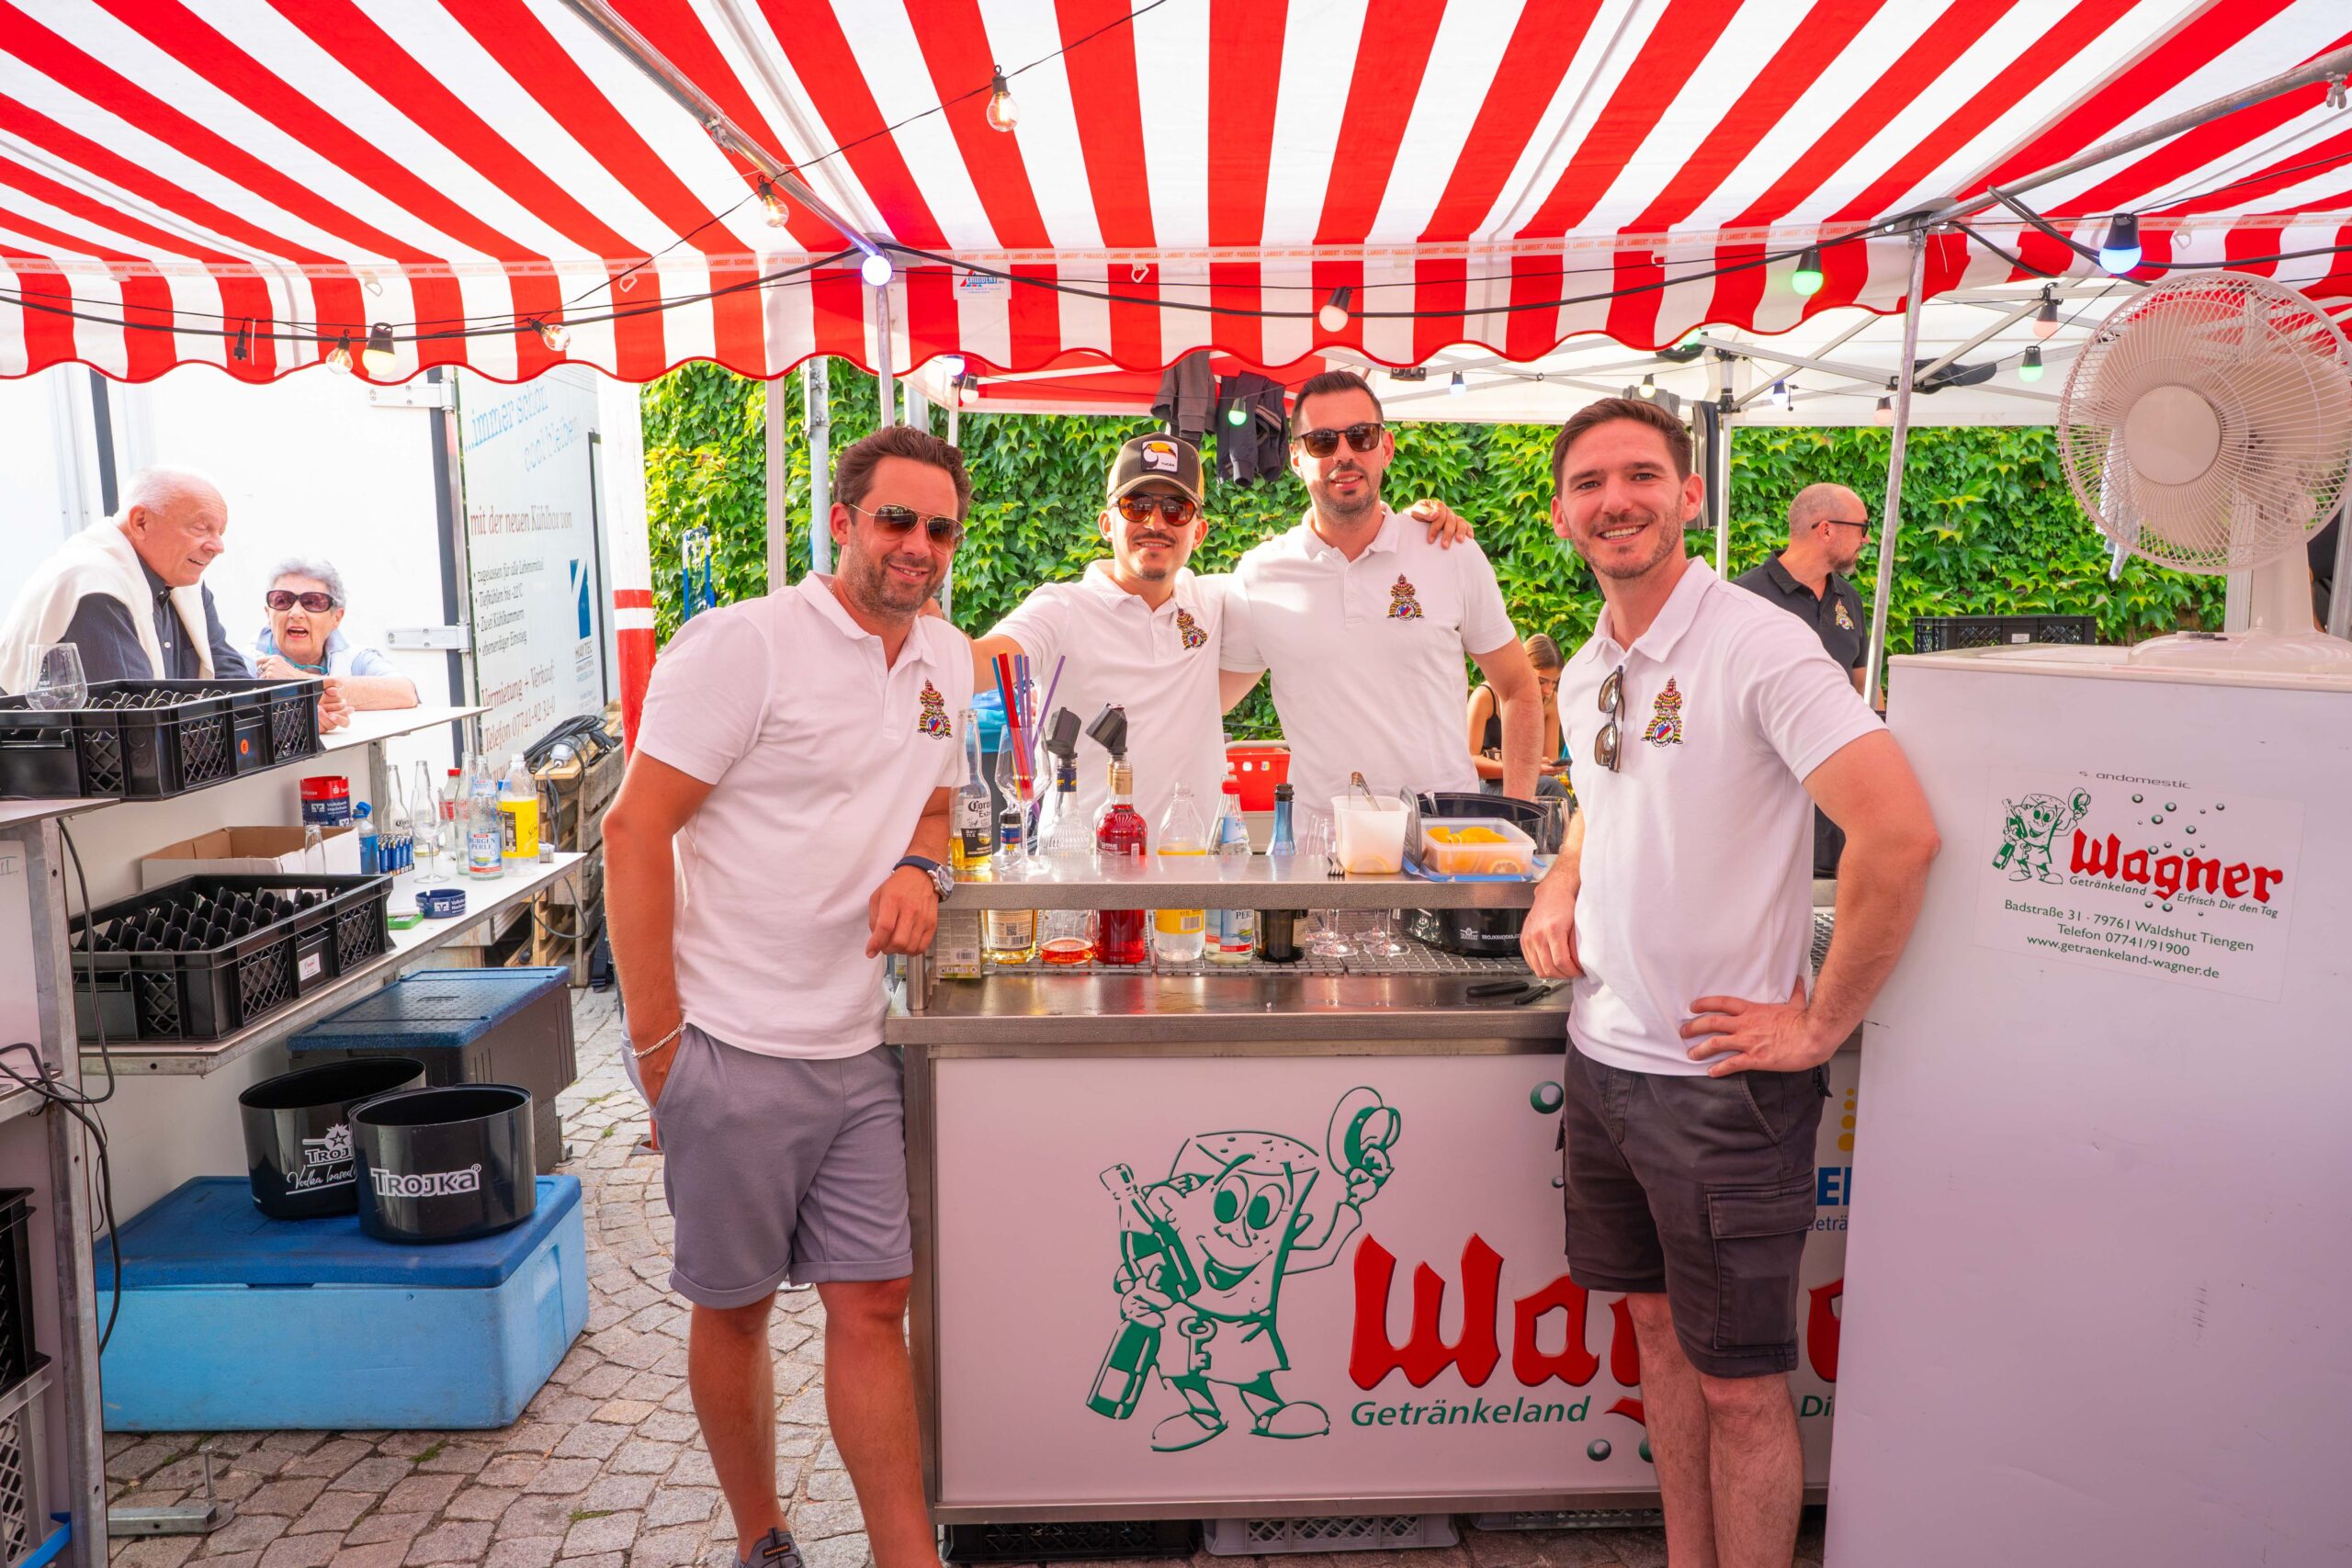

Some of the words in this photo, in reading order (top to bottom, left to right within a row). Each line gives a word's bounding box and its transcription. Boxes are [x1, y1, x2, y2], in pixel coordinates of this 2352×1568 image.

[469, 505, 486, 536] mit
[489, 505, 503, 535] der
[505, 511, 530, 534] neuen
[561, 511, 572, 529] von
[484, 719, 511, 752] Telefon
[2070, 828, 2284, 904] Wagner
[2069, 875, 2147, 897] Getränkeland
[2177, 892, 2216, 908] Erfrisch
[2219, 897, 2236, 910] Dir
[2239, 902, 2258, 915] den
[2259, 906, 2278, 919] Tag
[2004, 899, 2064, 919] Badstraße
[2067, 909, 2082, 922] 31
[2093, 913, 2132, 931] 79761
[2135, 920, 2198, 942] Waldshut
[2199, 931, 2255, 953] Tiengen
[2057, 923, 2101, 941] Telefon
[2105, 931, 2190, 957] 07741/91900
[2027, 934, 2220, 979] www.getraenkeland-wagner.de
[287, 1165, 323, 1190] Vodka
[326, 1165, 354, 1183] based
[1351, 1395, 1590, 1427] Getränkeland
